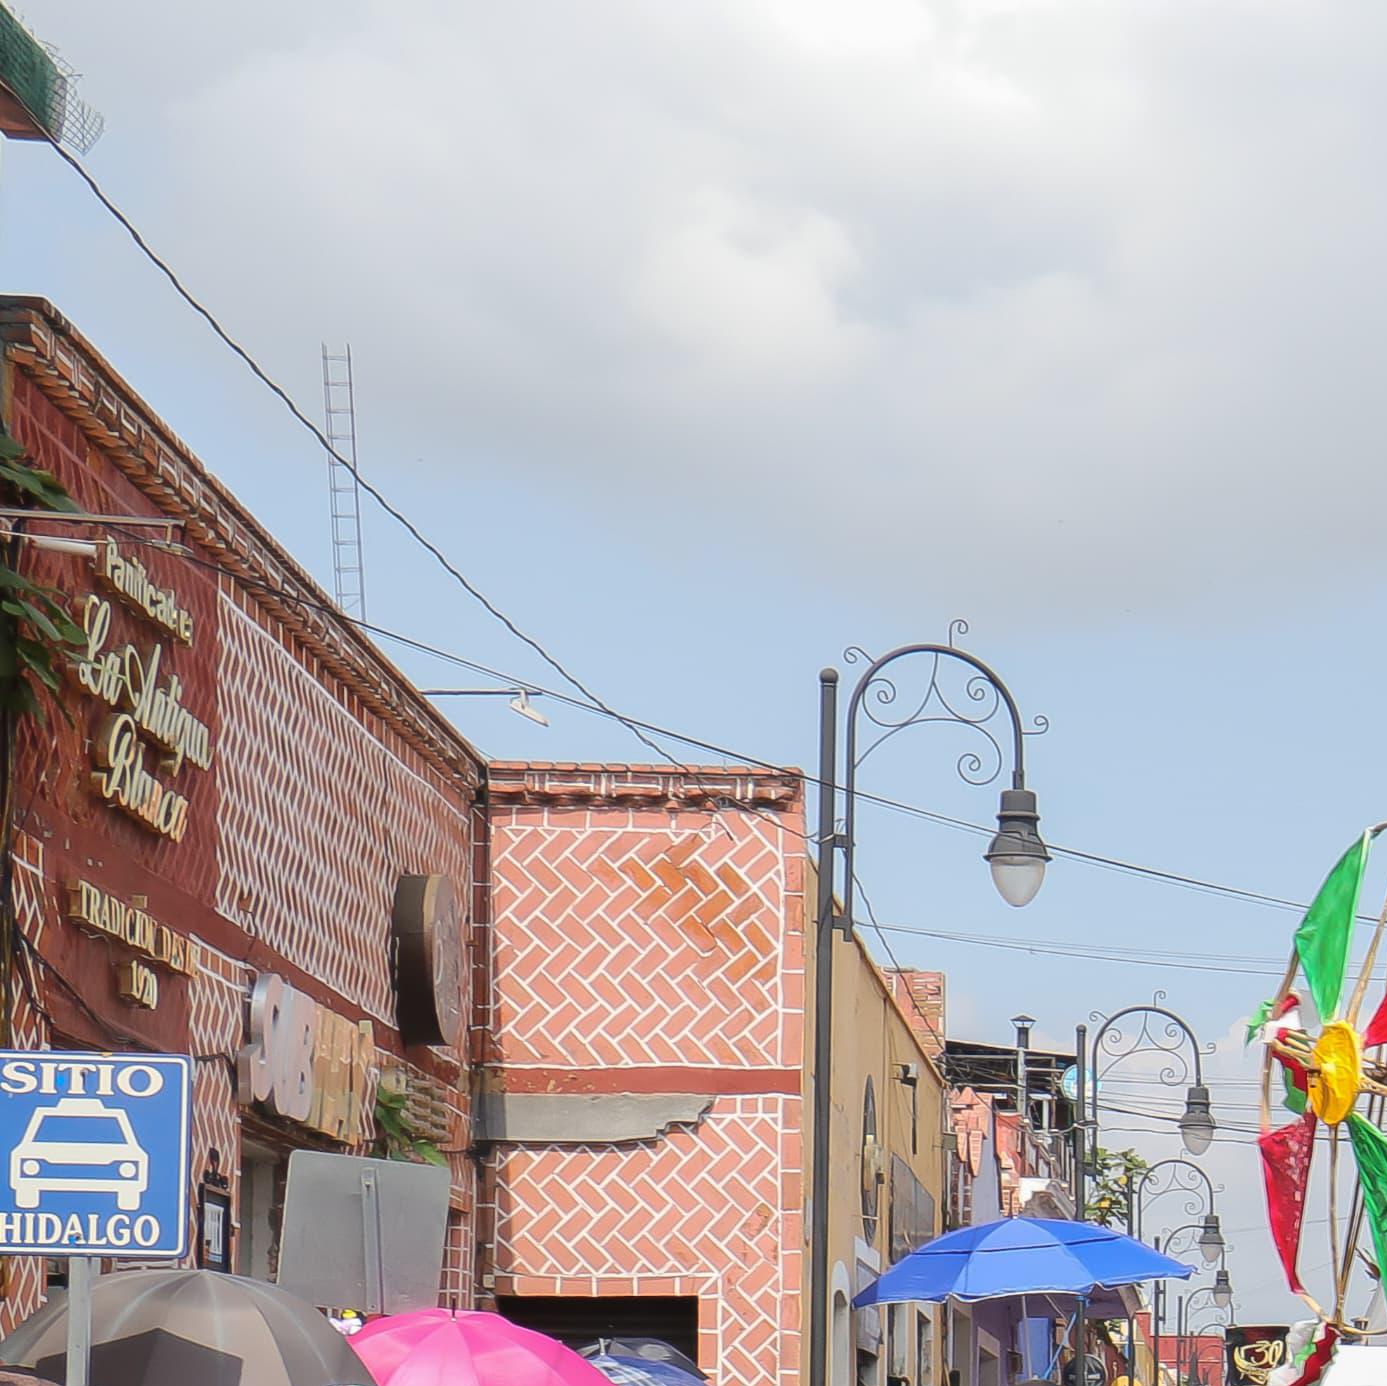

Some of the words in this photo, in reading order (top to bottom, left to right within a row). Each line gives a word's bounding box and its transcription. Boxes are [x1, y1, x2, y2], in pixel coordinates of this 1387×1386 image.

[79, 594, 124, 706] La
[125, 644, 214, 777] Antigua
[102, 714, 189, 844] Blanca
[1, 1061, 164, 1097] SITIO
[0, 1213, 160, 1246] HIDALGO
